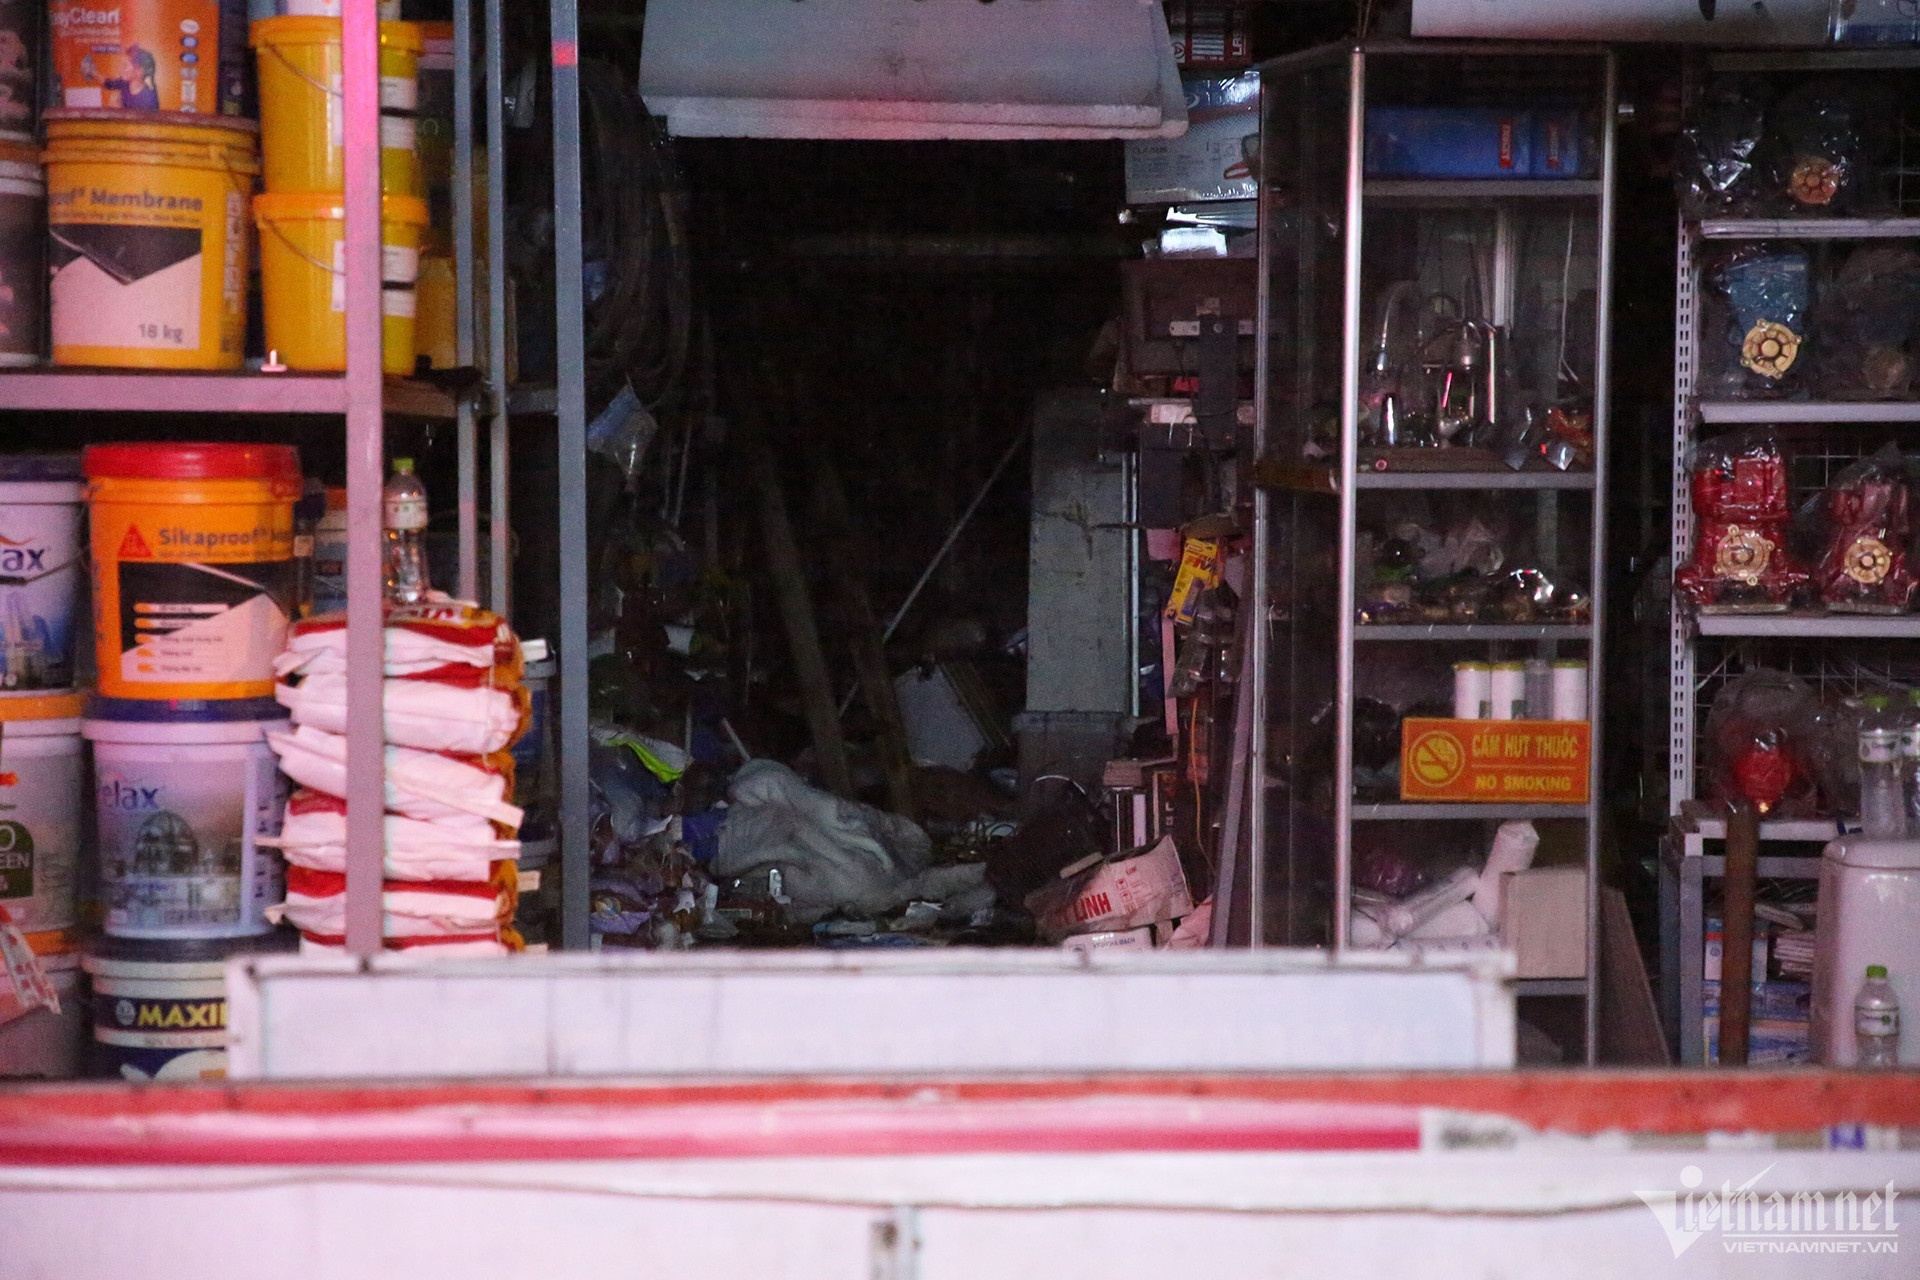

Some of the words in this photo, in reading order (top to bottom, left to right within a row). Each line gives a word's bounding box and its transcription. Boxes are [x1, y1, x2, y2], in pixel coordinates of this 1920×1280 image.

[92, 188, 203, 211] Membrane
[163, 324, 184, 344] kg
[1475, 775, 1498, 790] NO
[1504, 775, 1572, 792] SMOKING
